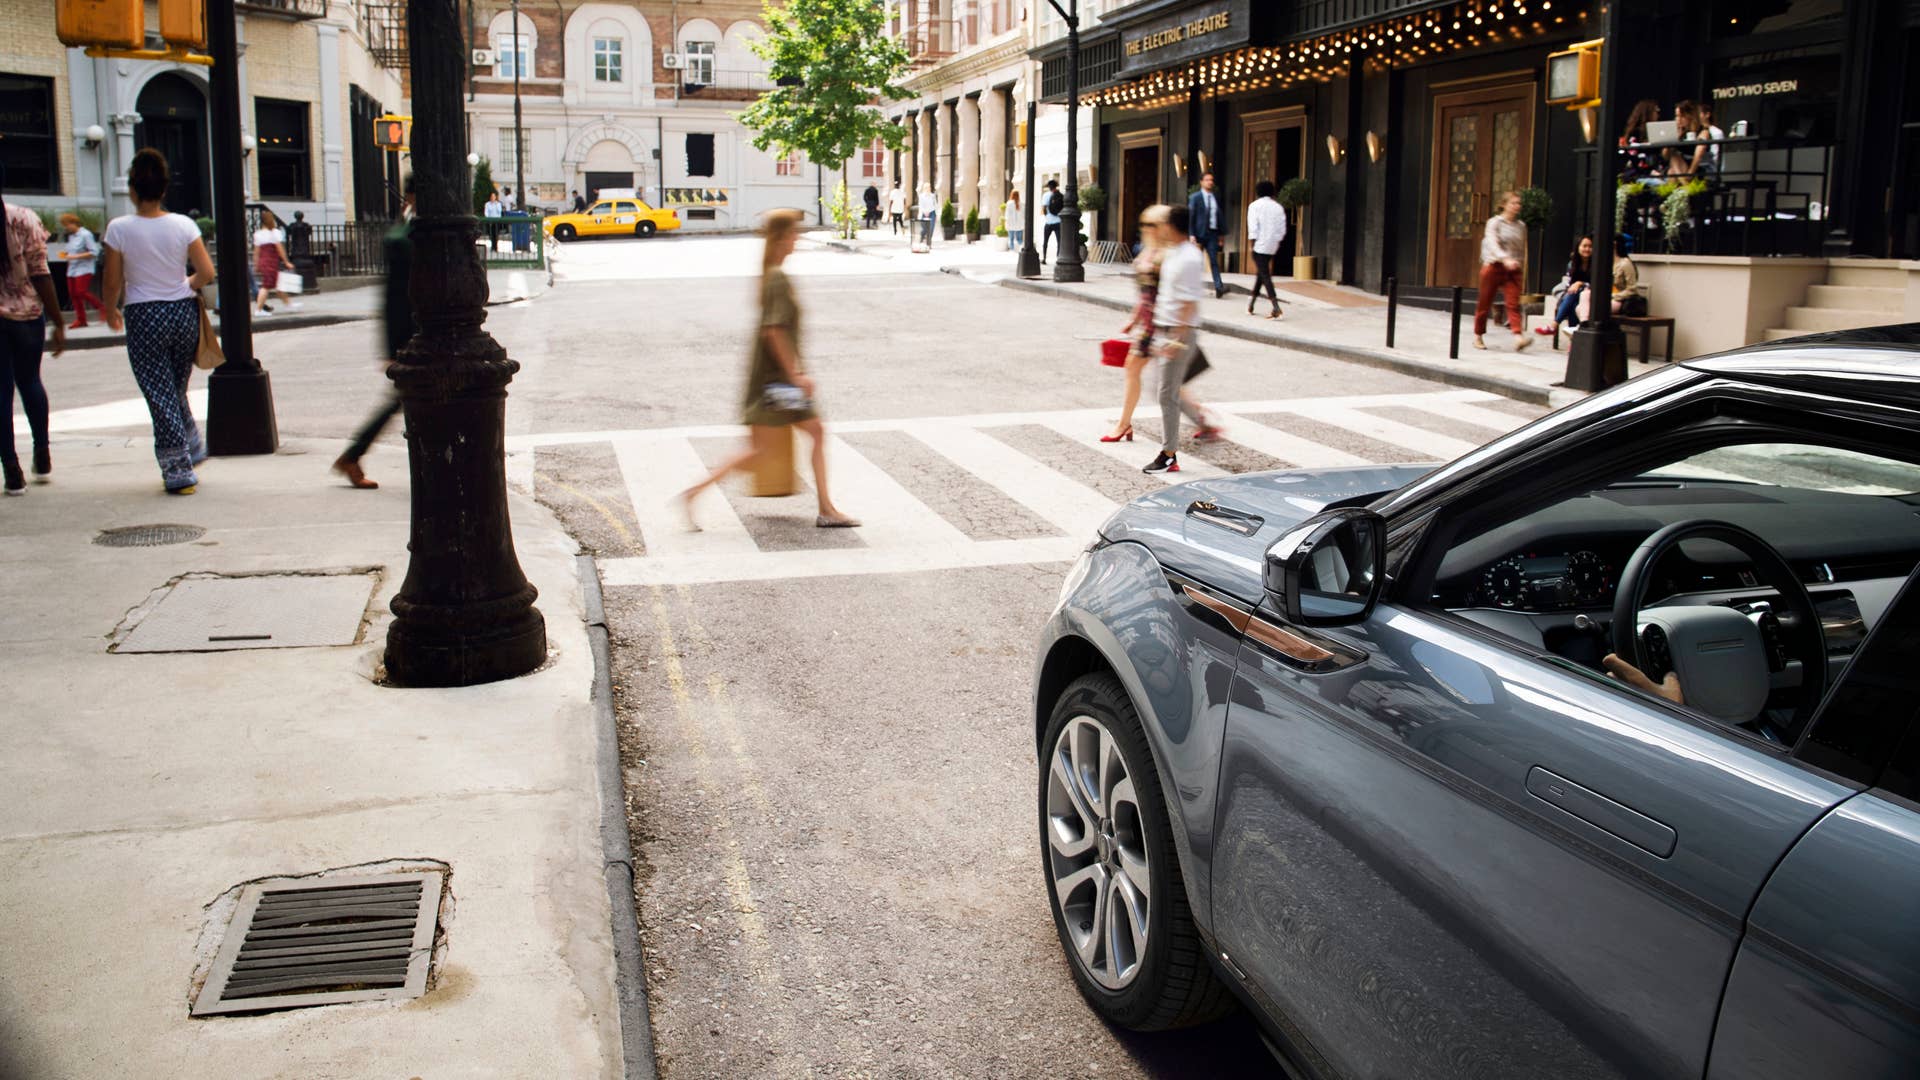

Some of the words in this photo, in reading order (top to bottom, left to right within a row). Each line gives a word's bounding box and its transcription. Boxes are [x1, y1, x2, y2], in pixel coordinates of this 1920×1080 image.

[1125, 40, 1140, 56] THE
[1143, 26, 1184, 51] ELECTRIC
[1185, 11, 1230, 38] THEATRE
[1712, 87, 1736, 99] TWO
[1738, 84, 1762, 96] TWO
[1763, 80, 1798, 94] SEVEN
